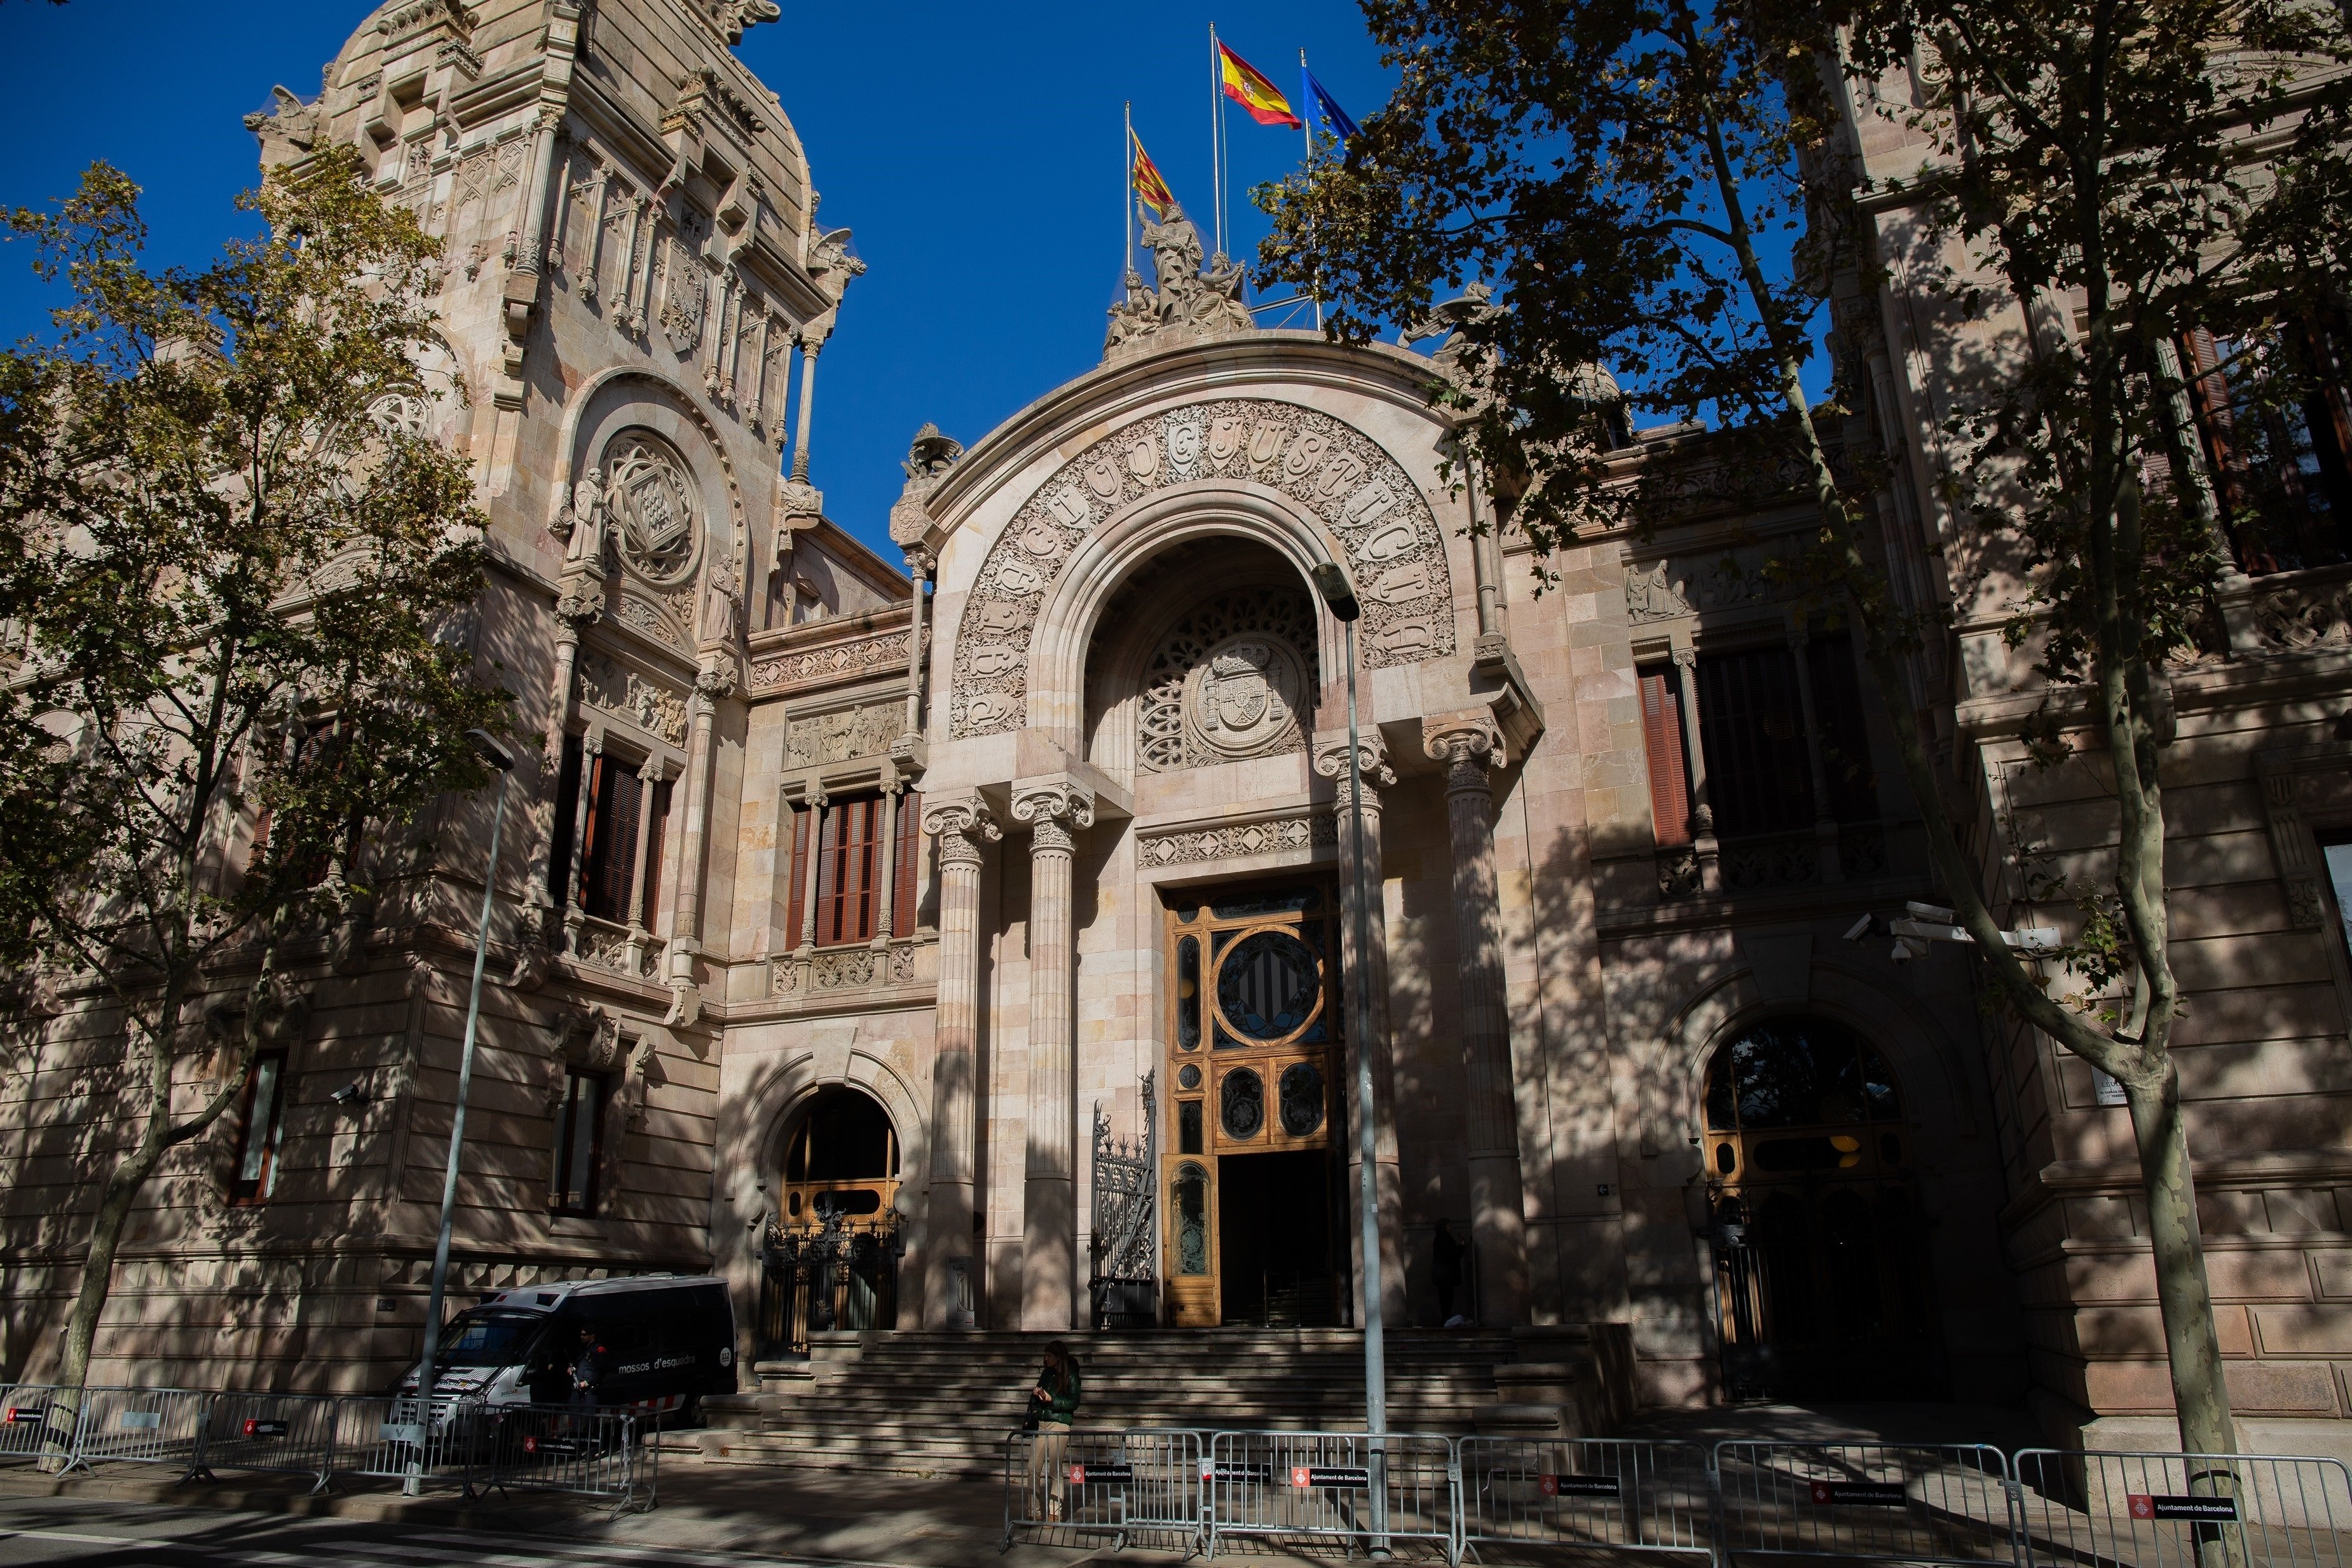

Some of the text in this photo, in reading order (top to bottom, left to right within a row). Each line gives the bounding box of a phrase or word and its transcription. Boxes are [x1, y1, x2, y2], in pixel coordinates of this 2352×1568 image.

[1126, 426, 1198, 478] DE
[1210, 418, 1432, 653] JUSTICIA
[619, 1354, 696, 1375] mossos d'esquadra
[1834, 1490, 1866, 1498] Ajuntament
